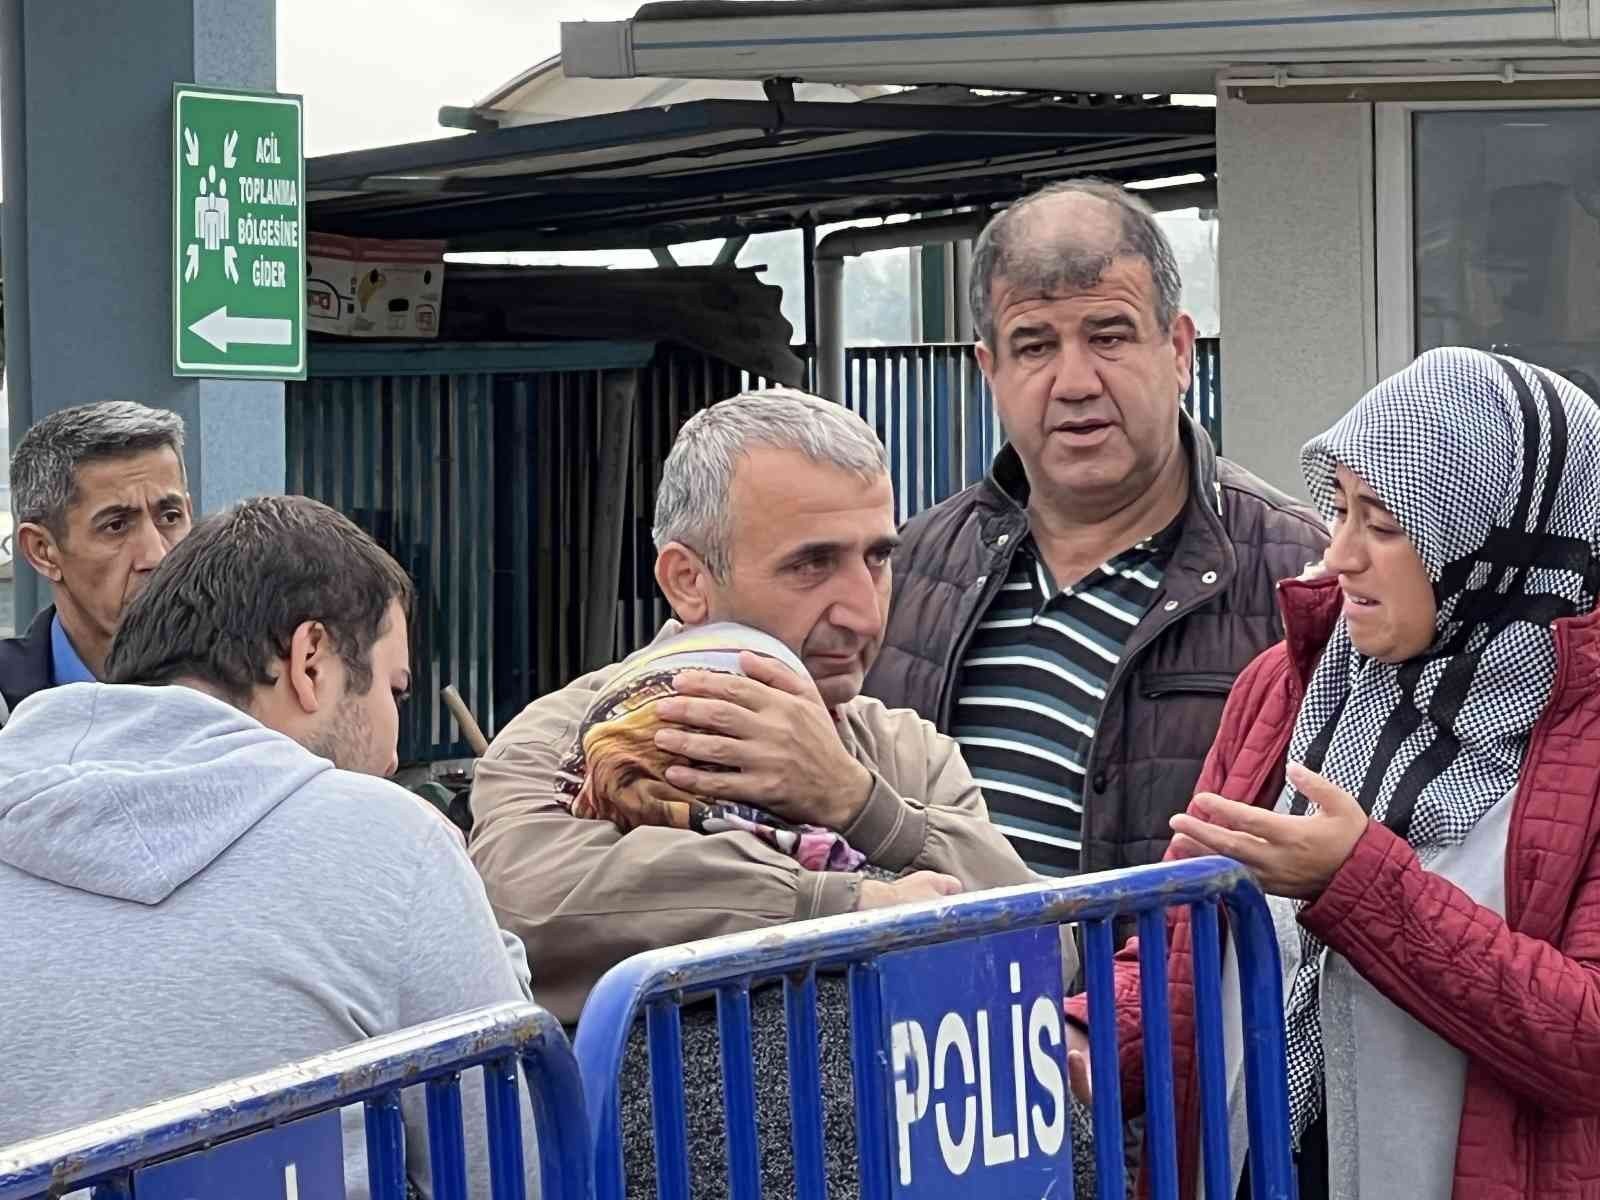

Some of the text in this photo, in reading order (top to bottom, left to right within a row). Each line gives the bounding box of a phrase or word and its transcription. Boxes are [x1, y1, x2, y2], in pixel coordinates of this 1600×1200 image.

[256, 132, 280, 164] ACİL
[239, 177, 297, 206] TOPLANMA
[238, 214, 298, 248] BÖLGESİNE
[253, 255, 286, 287] GİDER
[891, 962, 1065, 1185] POLİS
